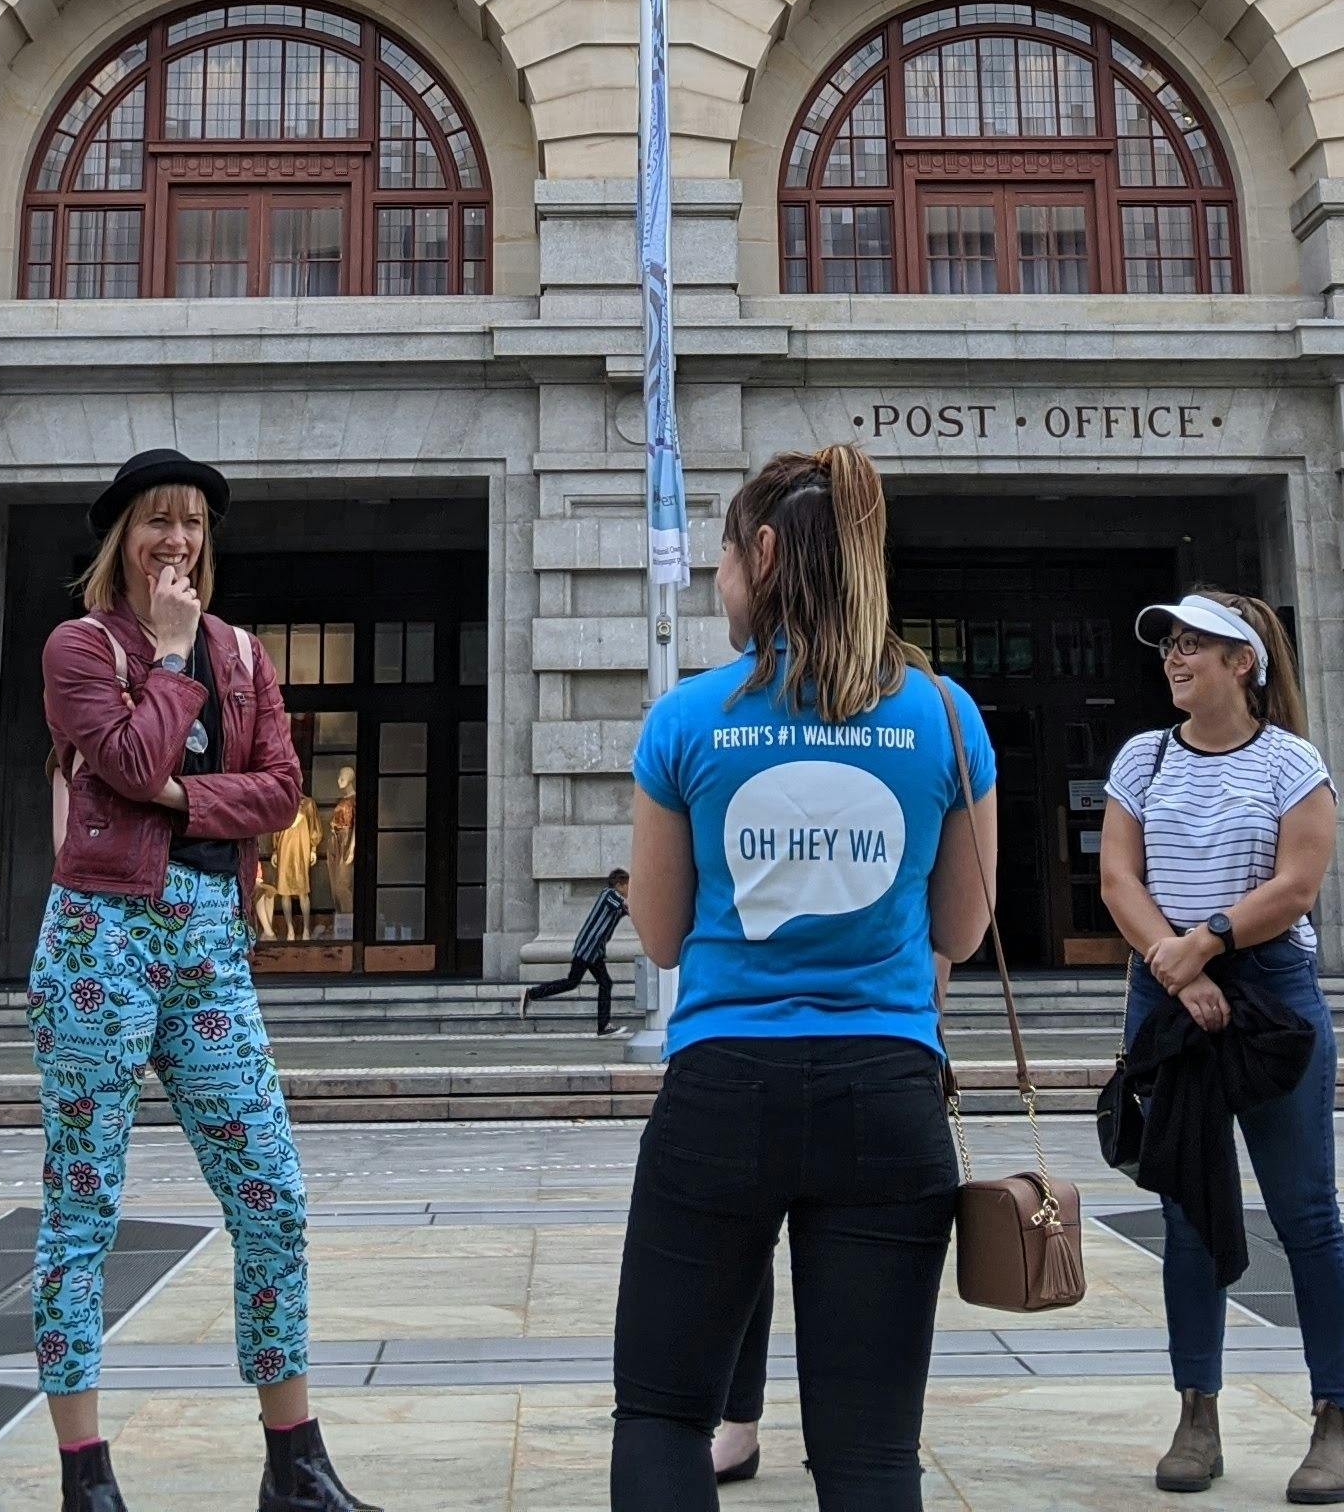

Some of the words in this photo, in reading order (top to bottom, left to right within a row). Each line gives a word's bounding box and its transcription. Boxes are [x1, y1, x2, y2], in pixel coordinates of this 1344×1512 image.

[872, 405, 996, 438] POST
[1044, 406, 1204, 439] OFFICE
[713, 725, 773, 750] PERTH'S
[778, 726, 796, 746] #1
[804, 725, 872, 748] WALKING
[875, 726, 916, 750] TOUR
[740, 828, 775, 861] OH
[789, 828, 839, 861] HEY
[850, 829, 887, 863] WA
